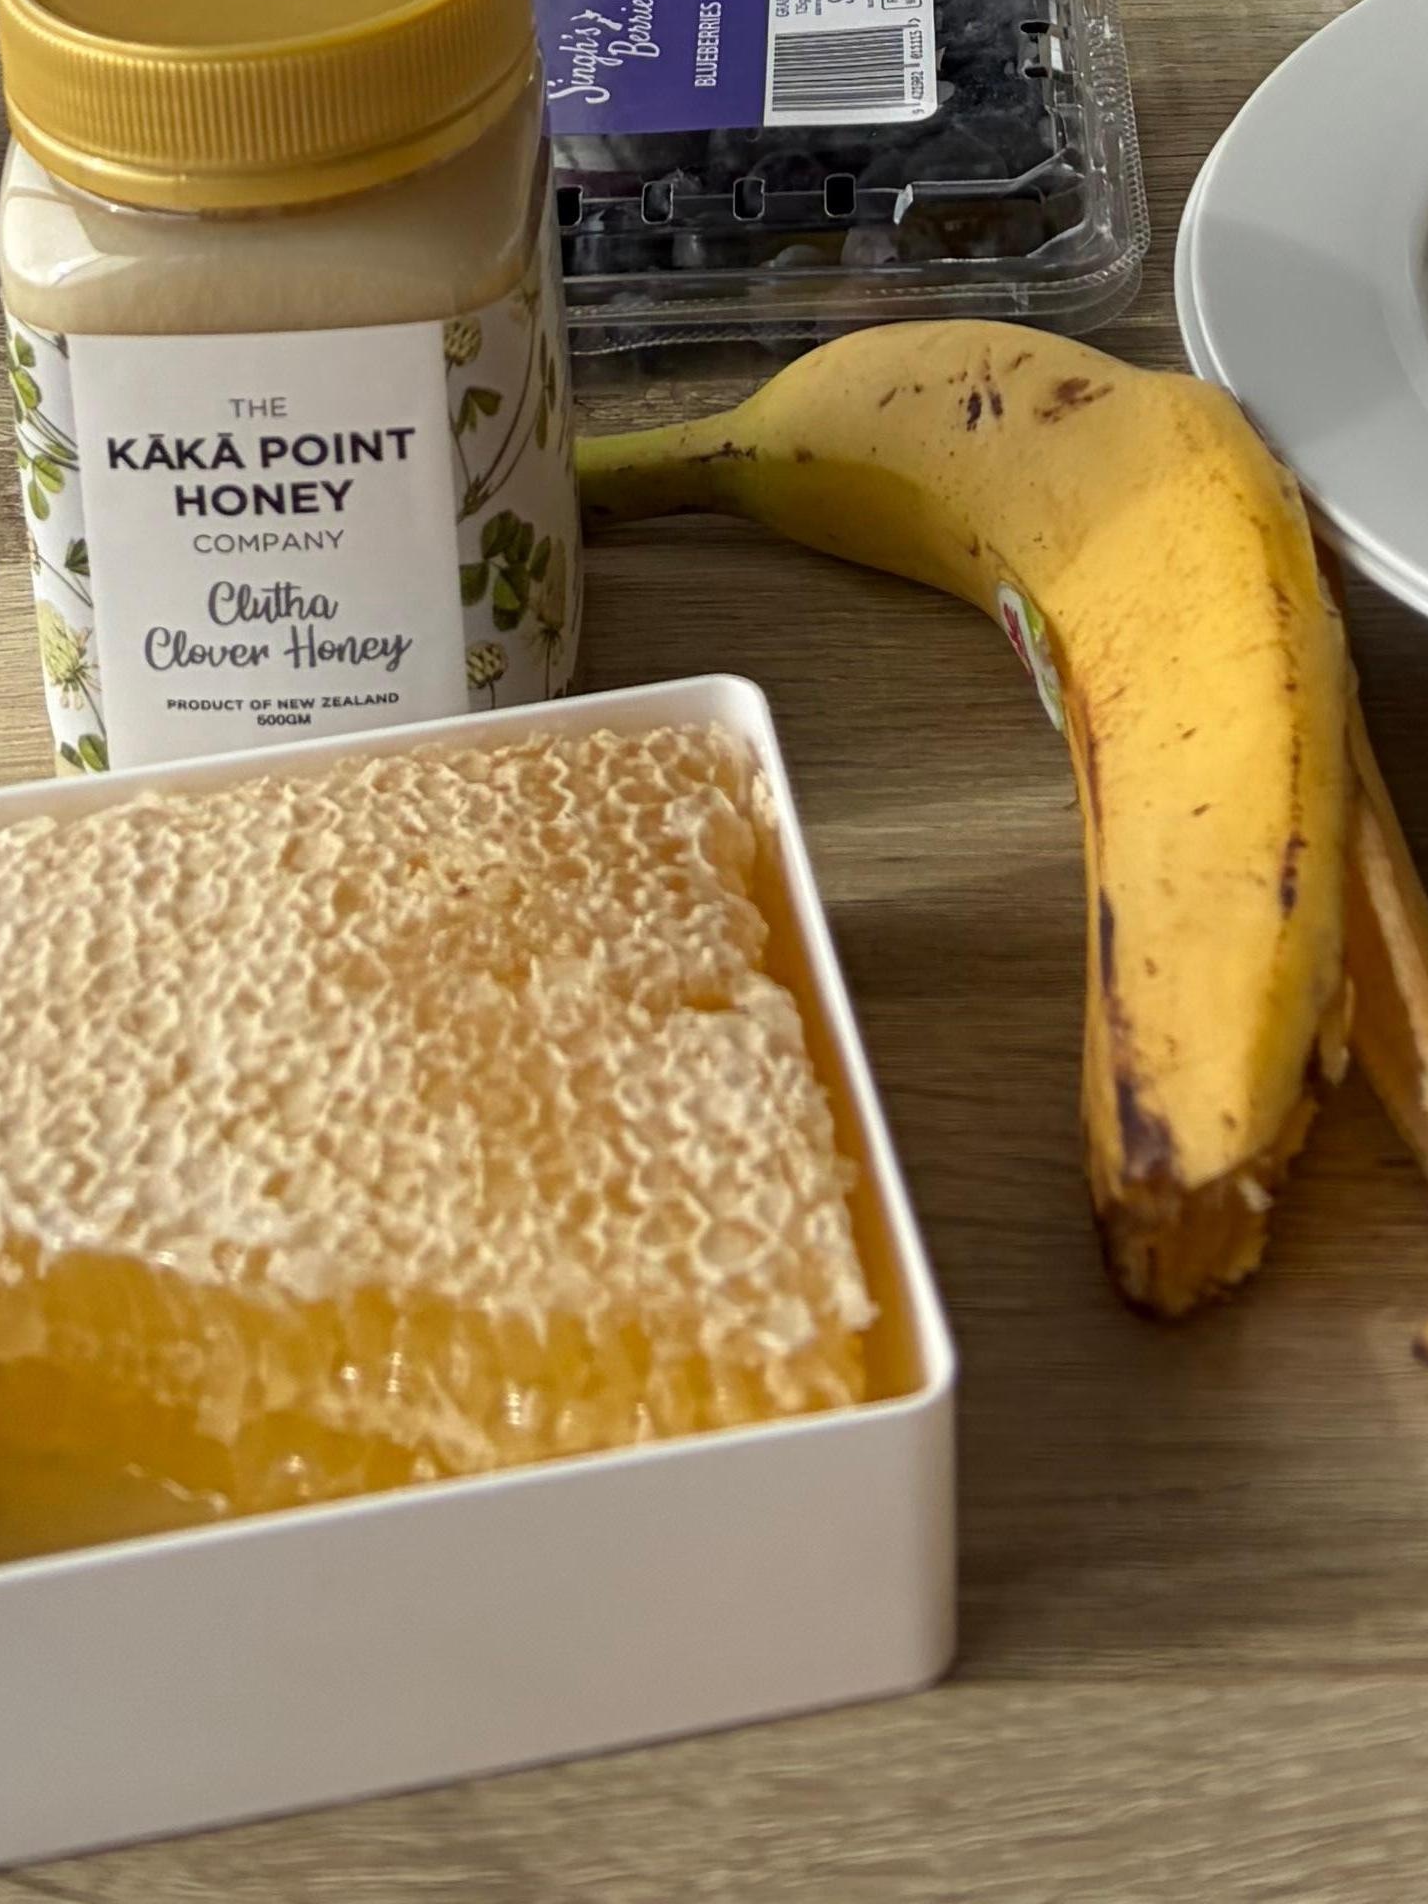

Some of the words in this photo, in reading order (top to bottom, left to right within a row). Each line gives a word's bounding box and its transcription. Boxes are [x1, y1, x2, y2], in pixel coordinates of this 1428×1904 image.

[547, 27, 623, 105] Singh's
[693, 1, 722, 87] BLUEBERRIES
[229, 397, 288, 418] THE
[107, 432, 246, 471] KĀKĀ
[260, 427, 416, 469] POINT
[174, 479, 355, 517] HONEY
[193, 529, 345, 554] COMPANY
[207, 580, 339, 626] Clutha
[144, 626, 271, 672] Clover
[283, 624, 413, 672] Honey
[166, 698, 246, 711] PRODUCT
[249, 698, 273, 710] OF
[276, 696, 316, 710] NEW
[320, 692, 400, 708] ZEALAND
